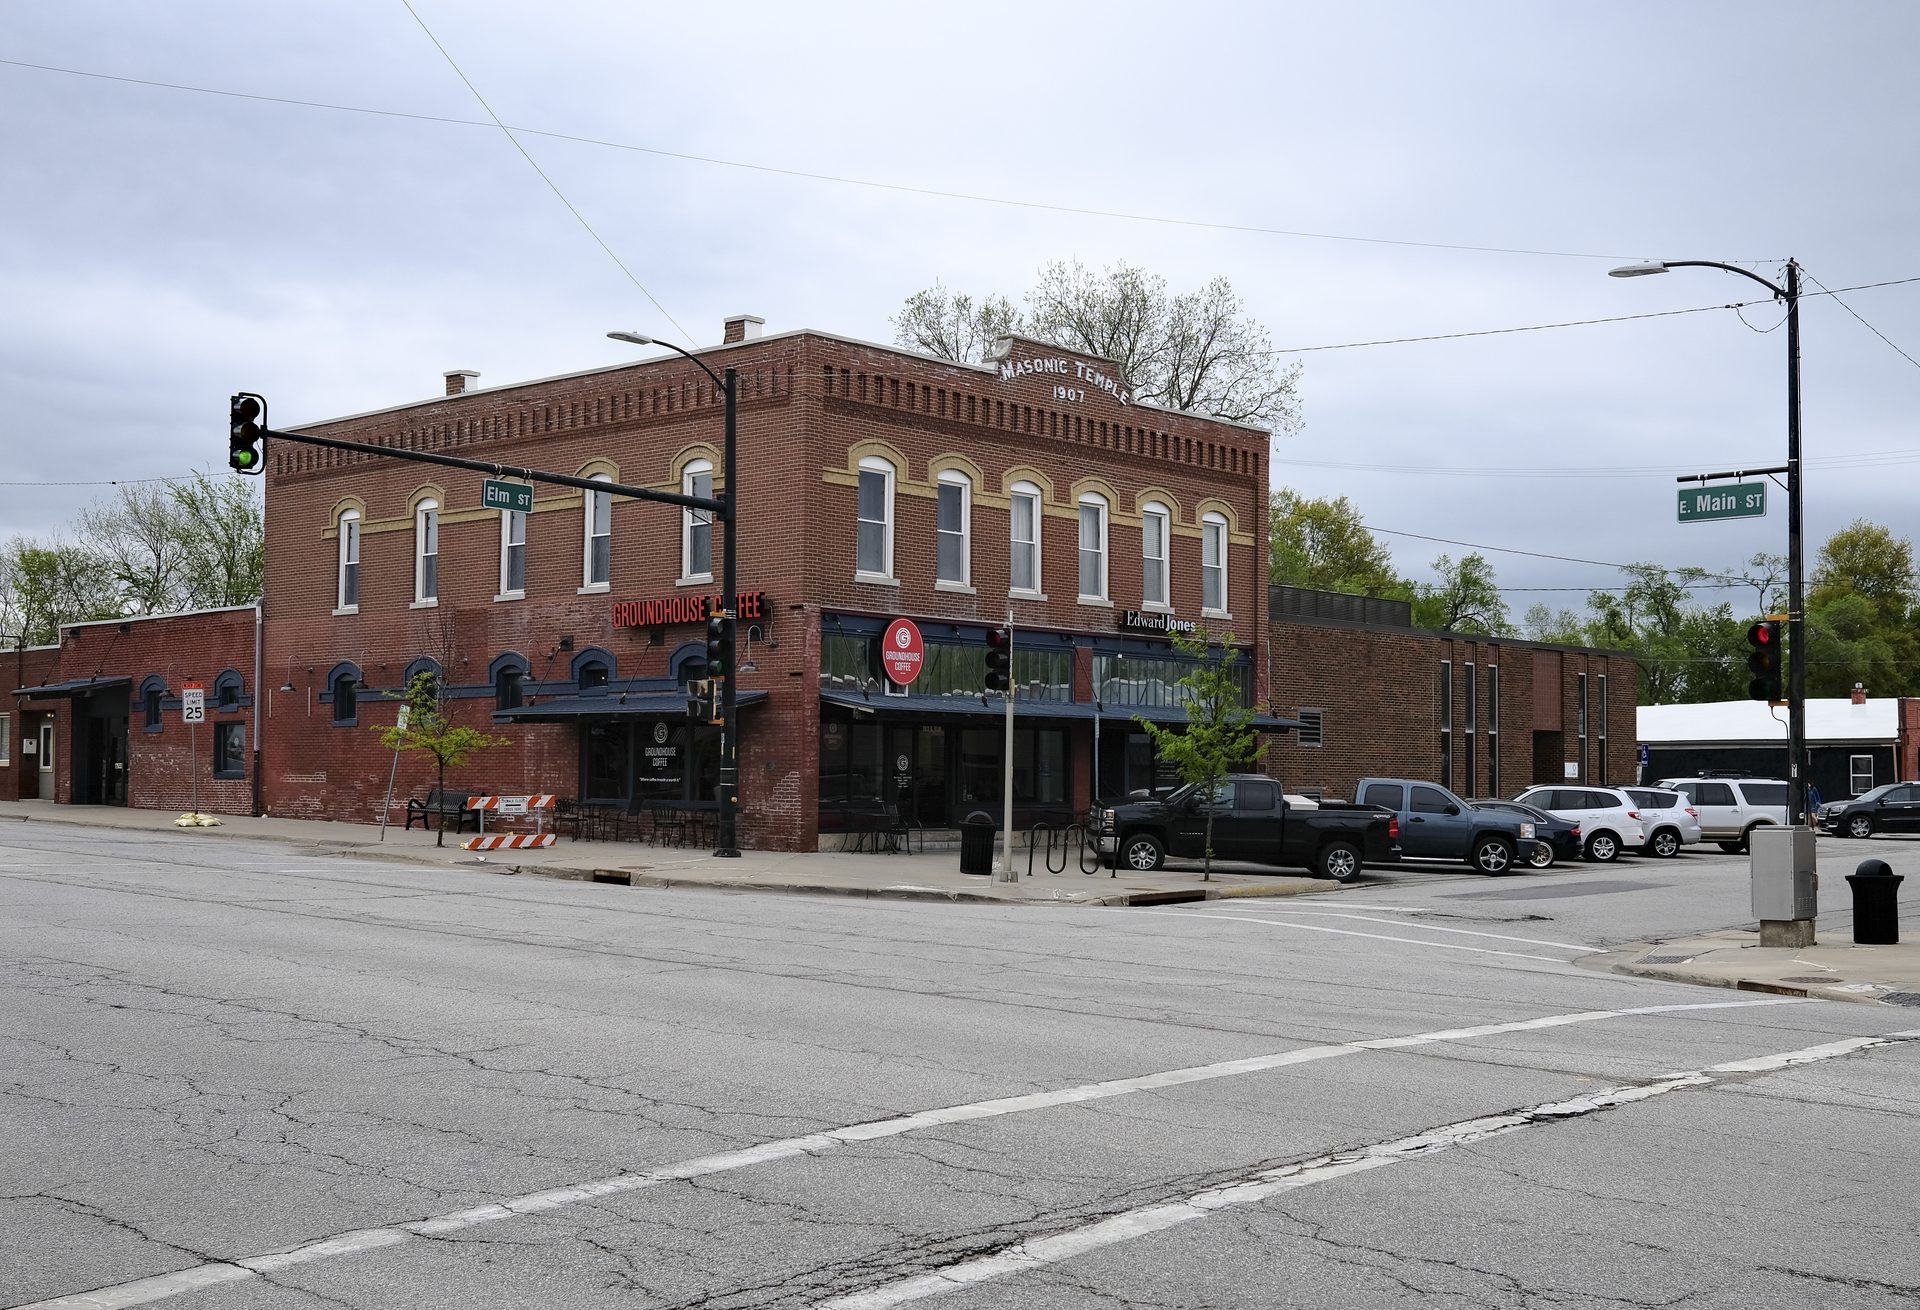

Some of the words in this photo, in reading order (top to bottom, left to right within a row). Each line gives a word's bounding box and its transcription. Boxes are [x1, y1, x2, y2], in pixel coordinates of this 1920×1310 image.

[1000, 358, 1068, 381] MASONIC
[1074, 361, 1130, 406] TEMPLE
[1052, 385, 1085, 403] 1907
[487, 486, 510, 503] Elm
[518, 493, 531, 506] ST
[1679, 500, 1691, 514] E.
[1696, 493, 1736, 512] Main
[1745, 493, 1762, 508] ST
[613, 595, 706, 628] GROUNDHOUSE
[714, 591, 761, 619] CFEE
[1127, 610, 1165, 629] Edward
[1165, 614, 1197, 632] Jones
[885, 650, 920, 662] GROUNDHOUSE
[895, 661, 911, 672] COFFEE
[185, 706, 203, 720] 25
[645, 746, 676, 757] GROUNDHOUSE
[652, 757, 668, 767] COFFEE
